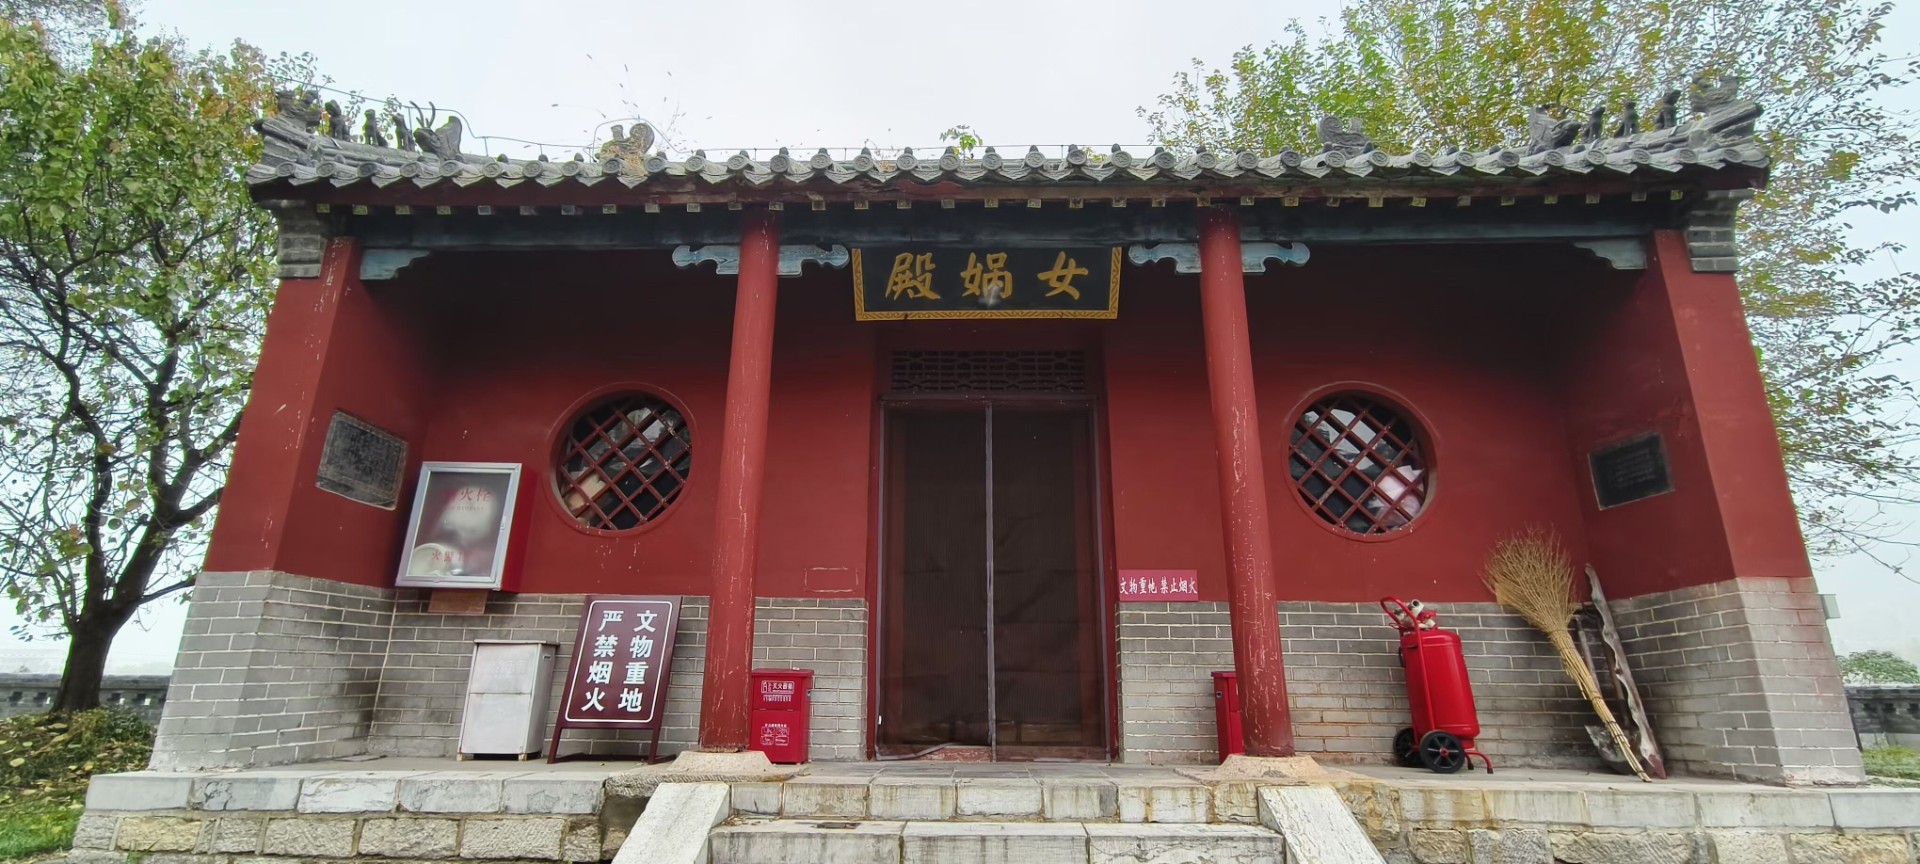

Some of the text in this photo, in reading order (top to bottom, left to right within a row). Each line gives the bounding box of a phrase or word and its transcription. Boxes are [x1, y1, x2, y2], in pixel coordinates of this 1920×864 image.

[1119, 576, 1198, 594] 文物重地 禁止烟火
[581, 610, 625, 712] 严禁烟火
[618, 609, 658, 713] 文物重地
